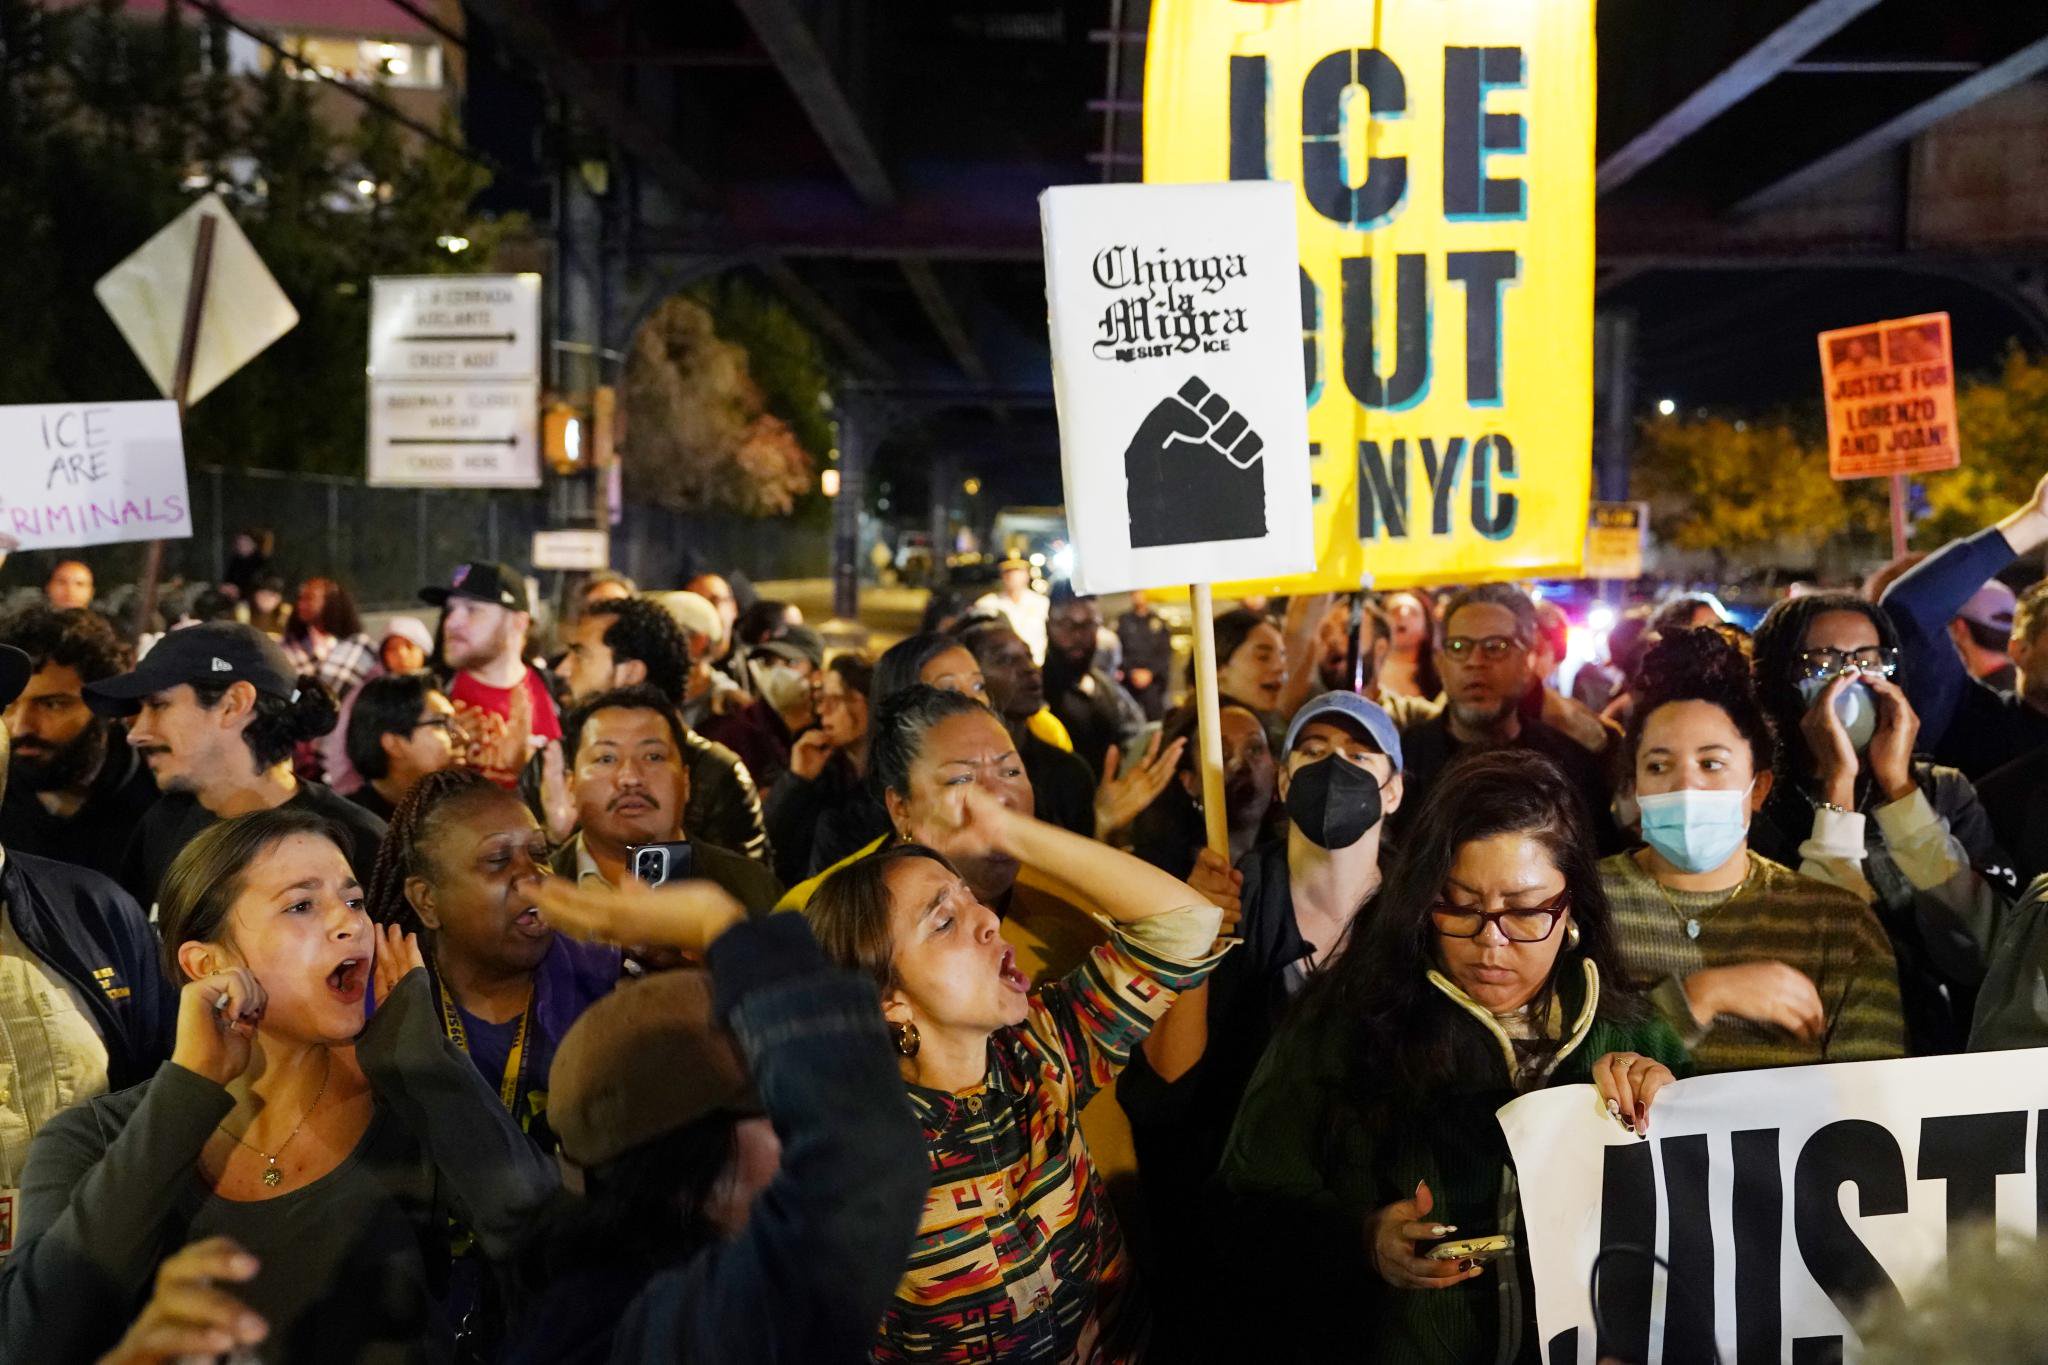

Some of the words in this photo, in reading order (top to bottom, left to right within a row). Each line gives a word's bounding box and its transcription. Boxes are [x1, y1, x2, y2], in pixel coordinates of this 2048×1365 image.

[1229, 46, 1527, 230] ICE
[1093, 245, 1248, 300] Chinga
[1166, 280, 1195, 312] la
[1093, 297, 1248, 360] Migra
[1202, 339, 1231, 354] ICE
[1299, 251, 1522, 412] UT
[41, 408, 112, 450] ICE
[1846, 396, 1936, 432] LORENZO
[1839, 433, 1880, 457] AND
[47, 450, 109, 490] ARE
[1357, 433, 1518, 541] NYC
[0, 495, 185, 536] RIMINALS
[1549, 1108, 2048, 1365] JUST
